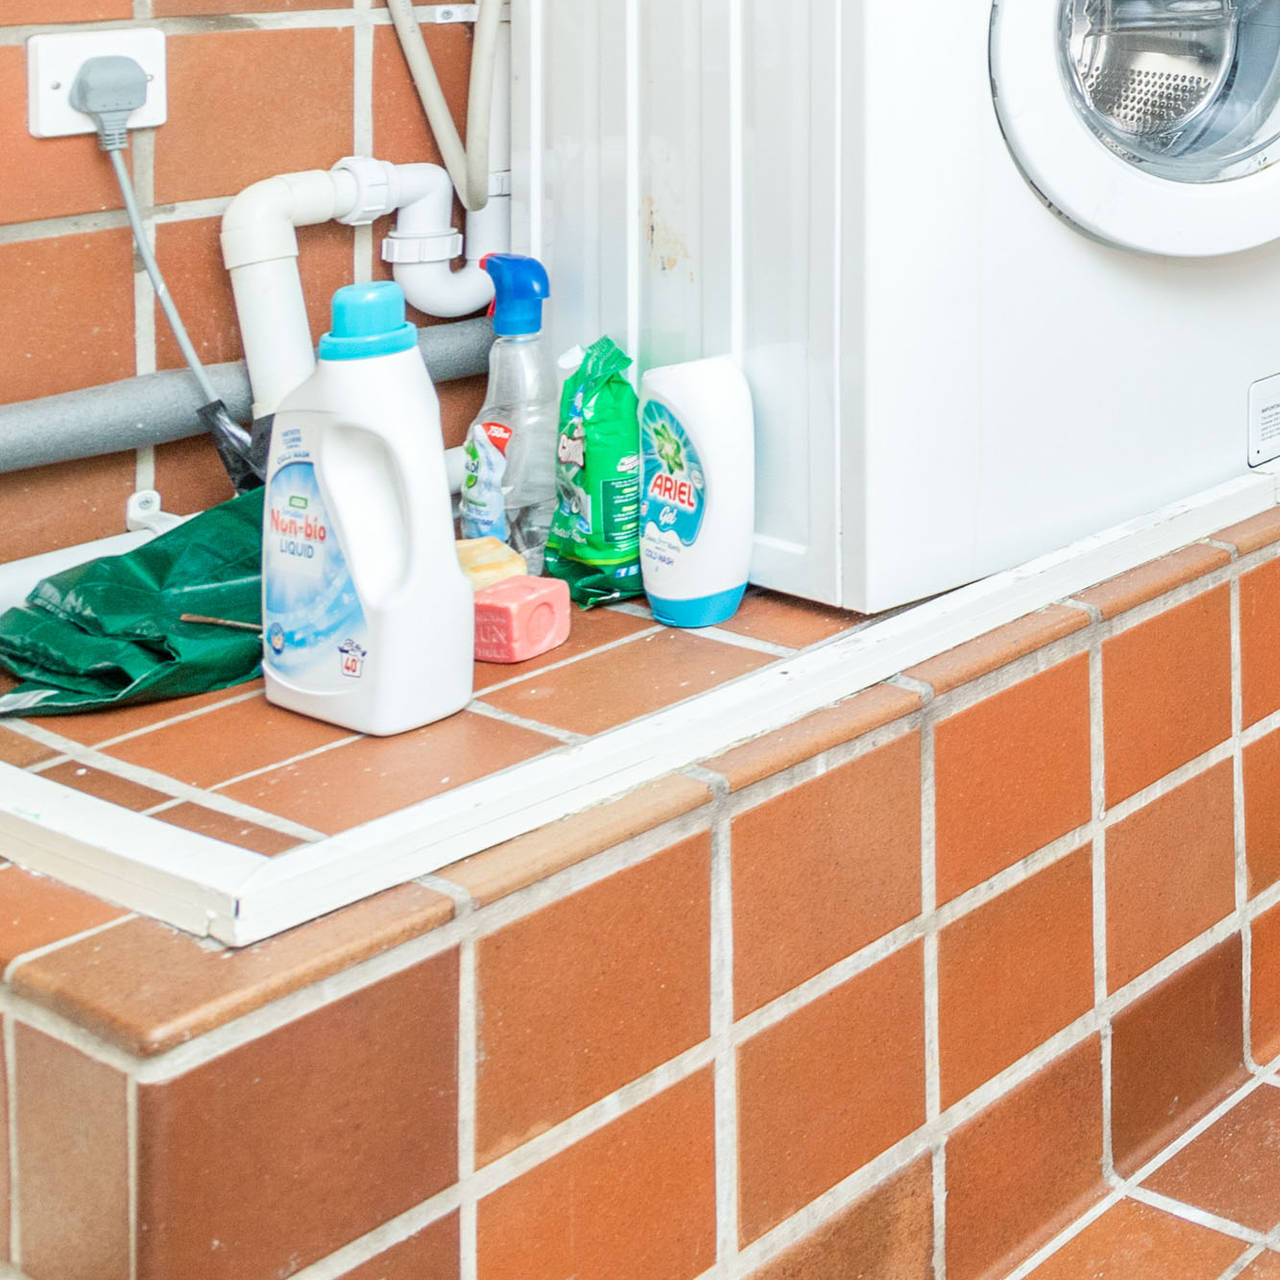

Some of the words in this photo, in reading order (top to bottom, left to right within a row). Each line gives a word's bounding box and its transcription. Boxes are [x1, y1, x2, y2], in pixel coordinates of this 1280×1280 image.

[650, 474, 695, 508] ARIEL
[270, 508, 327, 543] Non-bio
[659, 505, 677, 526] Gel
[280, 539, 314, 559] LIQUID
